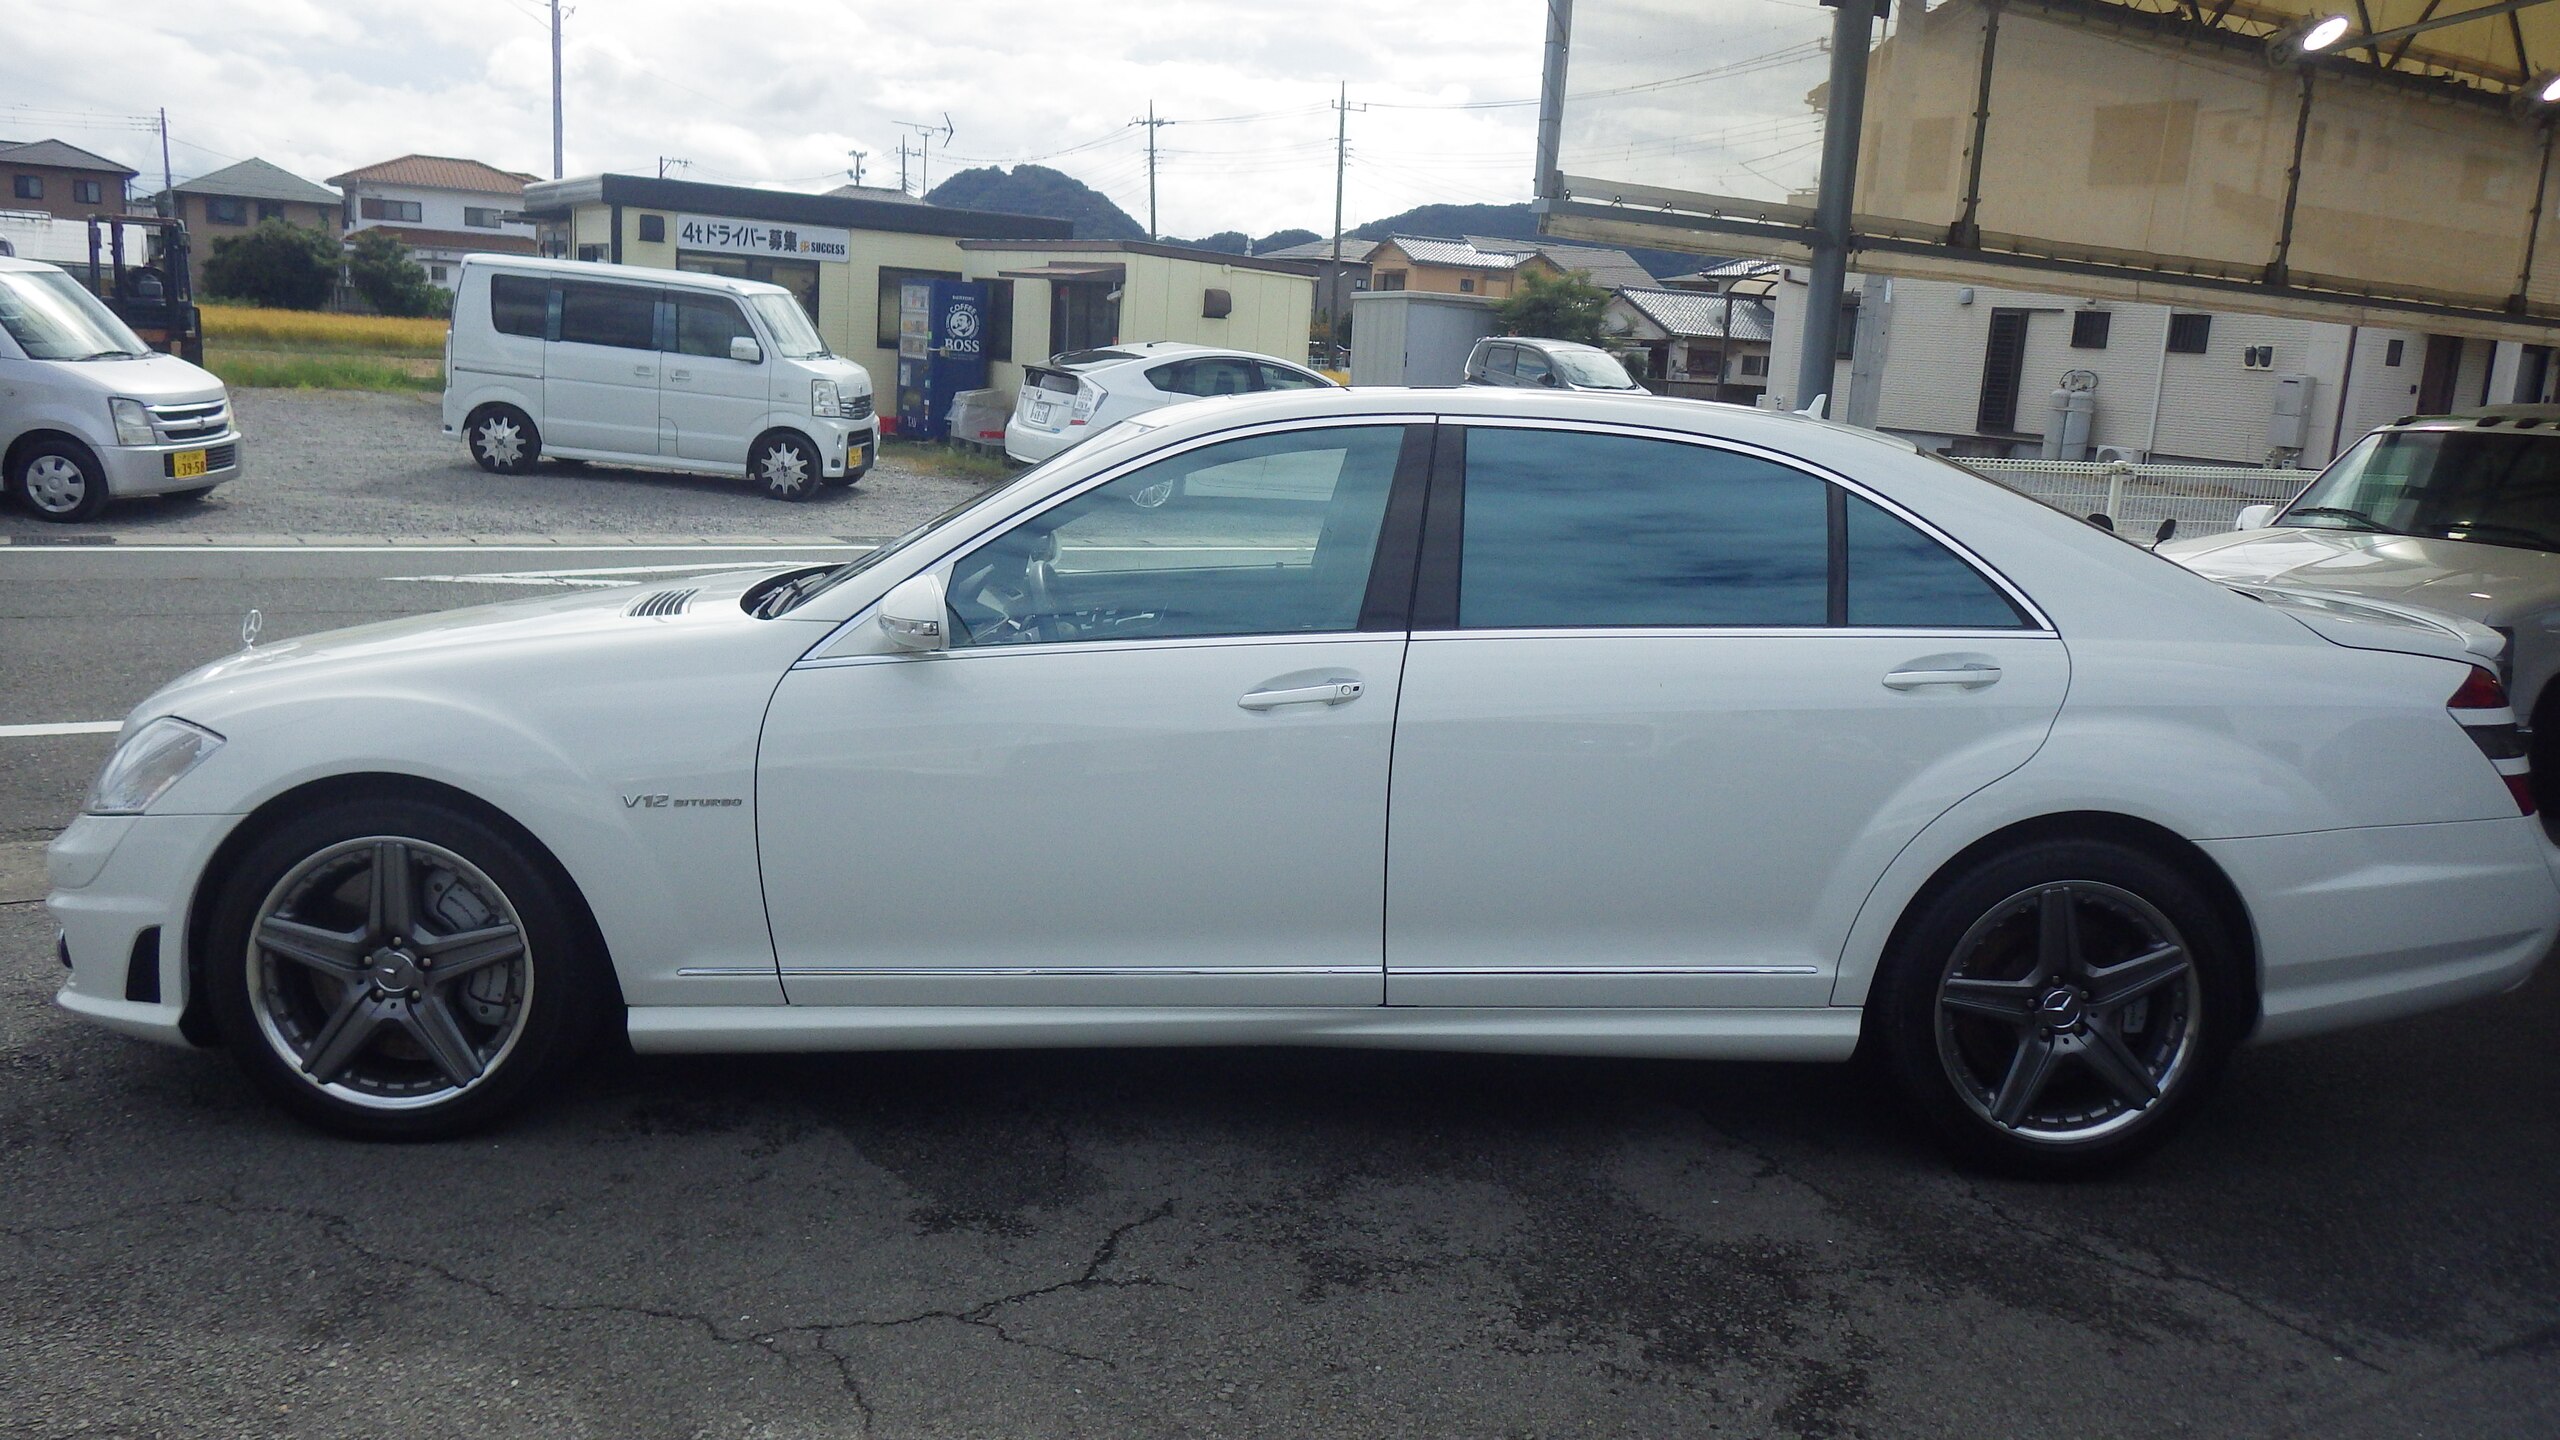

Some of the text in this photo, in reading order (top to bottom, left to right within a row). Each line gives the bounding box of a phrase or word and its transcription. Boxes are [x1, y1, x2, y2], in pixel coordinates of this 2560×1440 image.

[682, 221, 798, 253] 4tドライバー募集
[811, 241, 846, 256] SUCCESS
[949, 303, 977, 316] COFFEE
[944, 338, 980, 353] BOSS
[623, 794, 743, 808] V12 BITURBO
